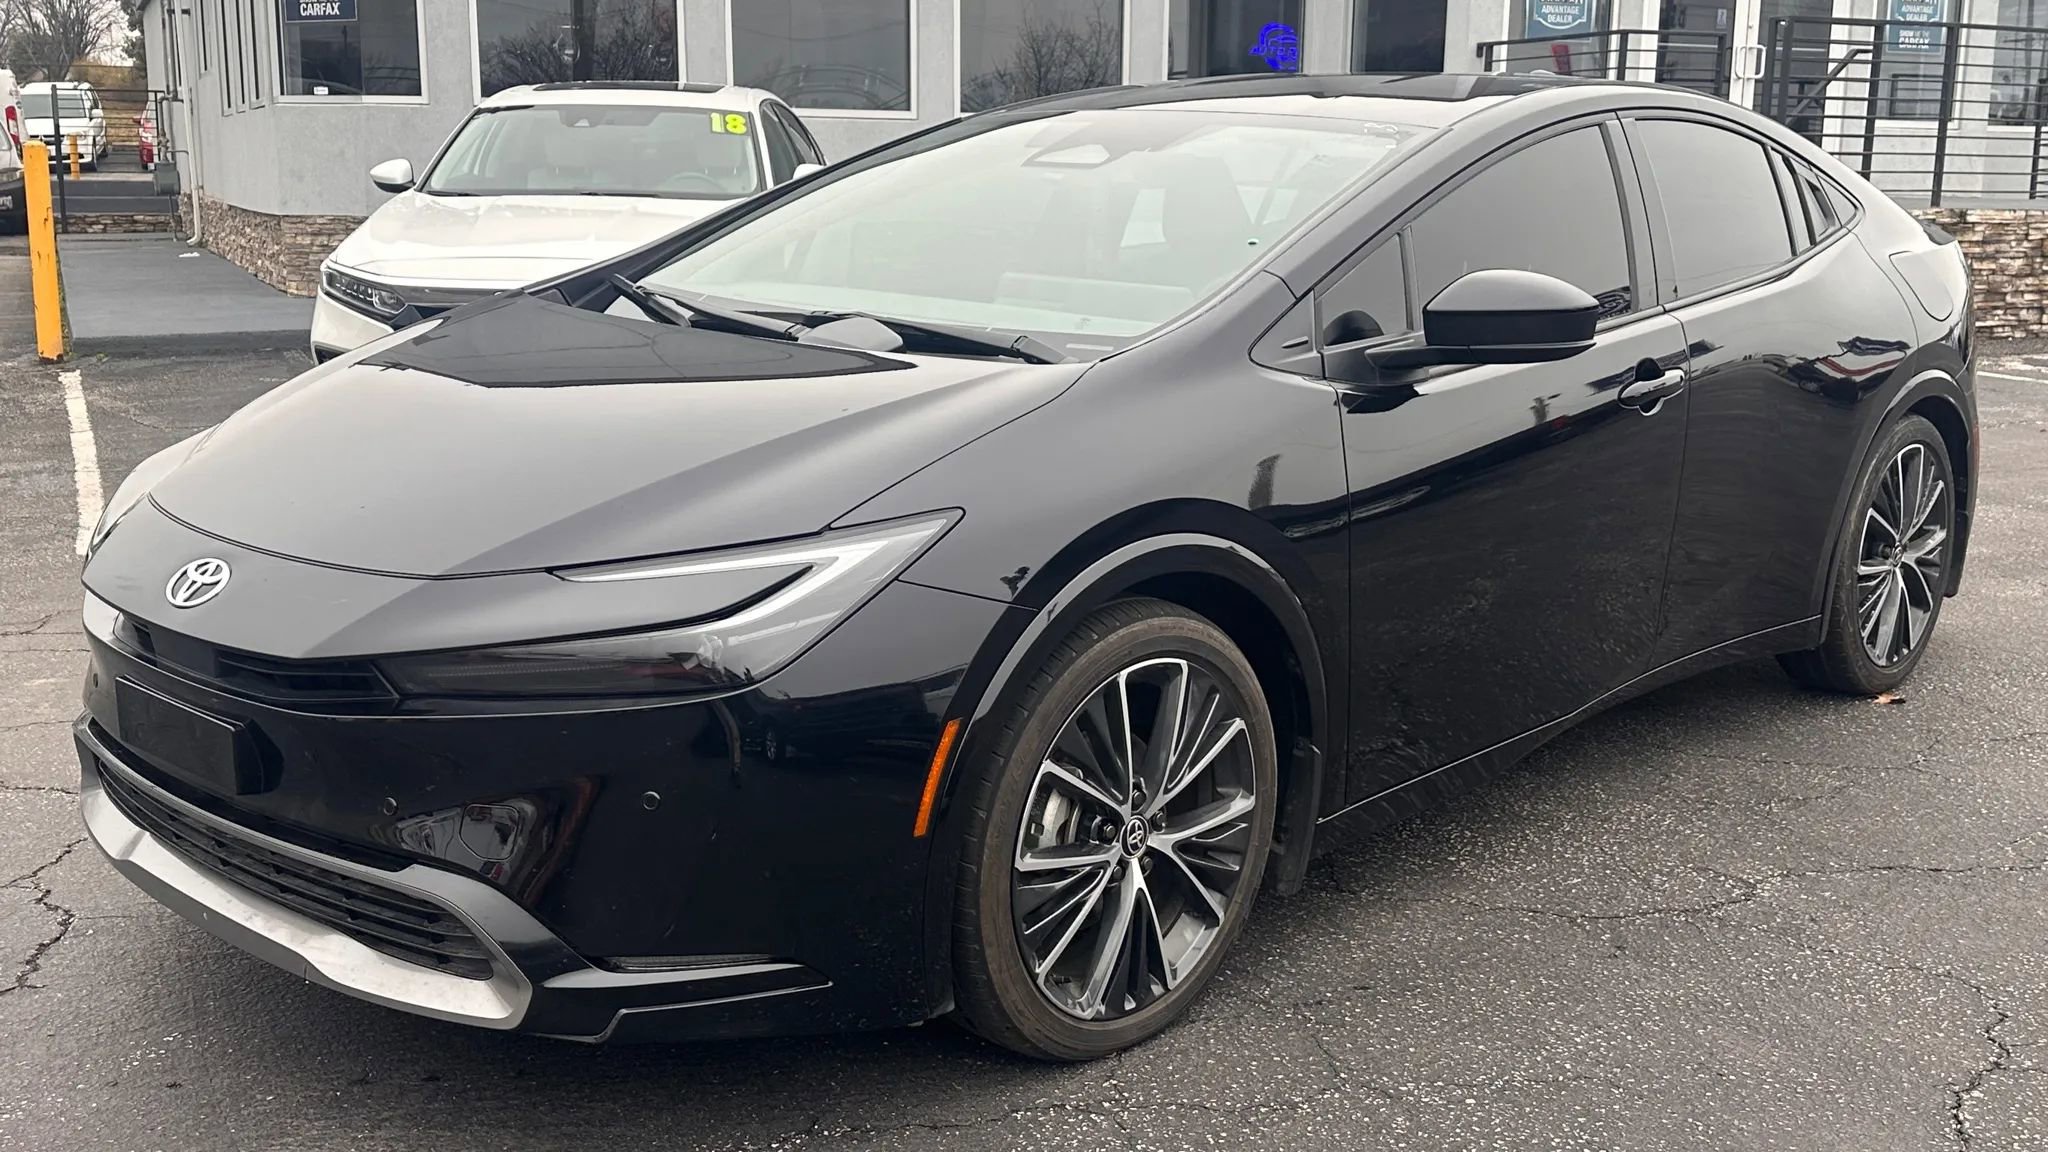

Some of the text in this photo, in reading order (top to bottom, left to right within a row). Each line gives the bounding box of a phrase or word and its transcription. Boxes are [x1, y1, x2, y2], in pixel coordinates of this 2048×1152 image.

[300, 2, 340, 16] CARFAX
[1541, 5, 1580, 14] ADVANTAGE
[1901, 4, 1934, 14] ADVANTAGE
[1547, 14, 1573, 23] DEALER
[1906, 13, 1928, 21] DEALER
[1899, 37, 1930, 49] CARFAX
[711, 112, 747, 134] 18
